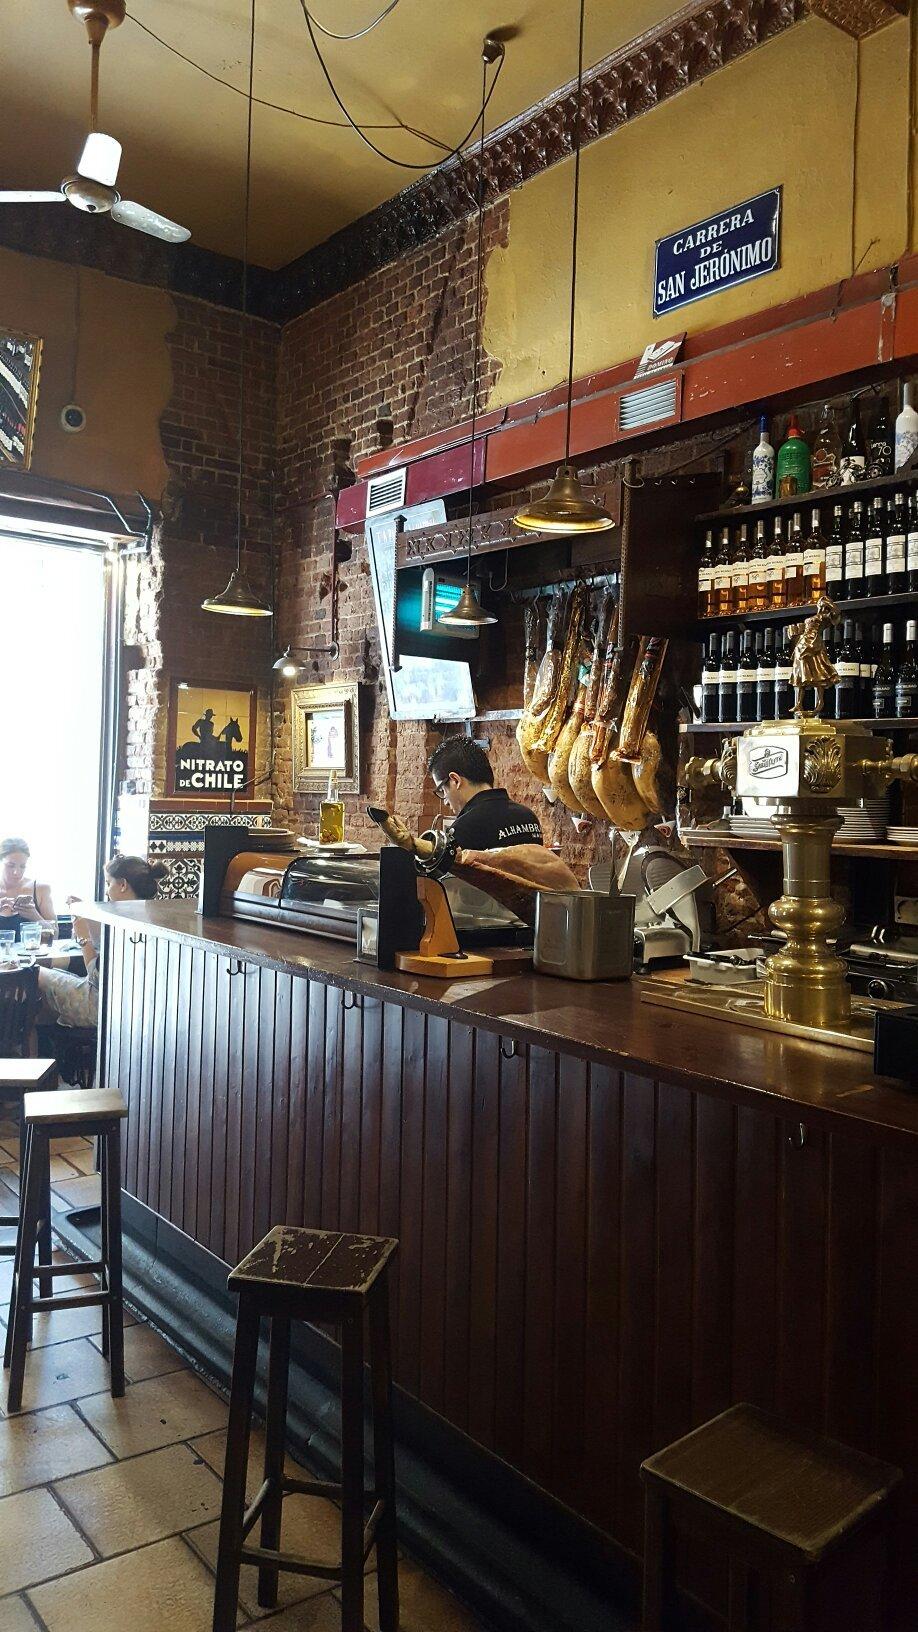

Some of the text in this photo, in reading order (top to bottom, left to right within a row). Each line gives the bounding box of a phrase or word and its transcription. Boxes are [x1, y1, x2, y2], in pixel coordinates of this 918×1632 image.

[673, 208, 755, 255] CARRERA
[699, 240, 723, 259] DE
[657, 236, 773, 305] SAN JERÓNIMO
[180, 758, 244, 773] NITRATO
[179, 772, 245, 790] DE CHILE
[498, 823, 541, 840] ALHAMBR
